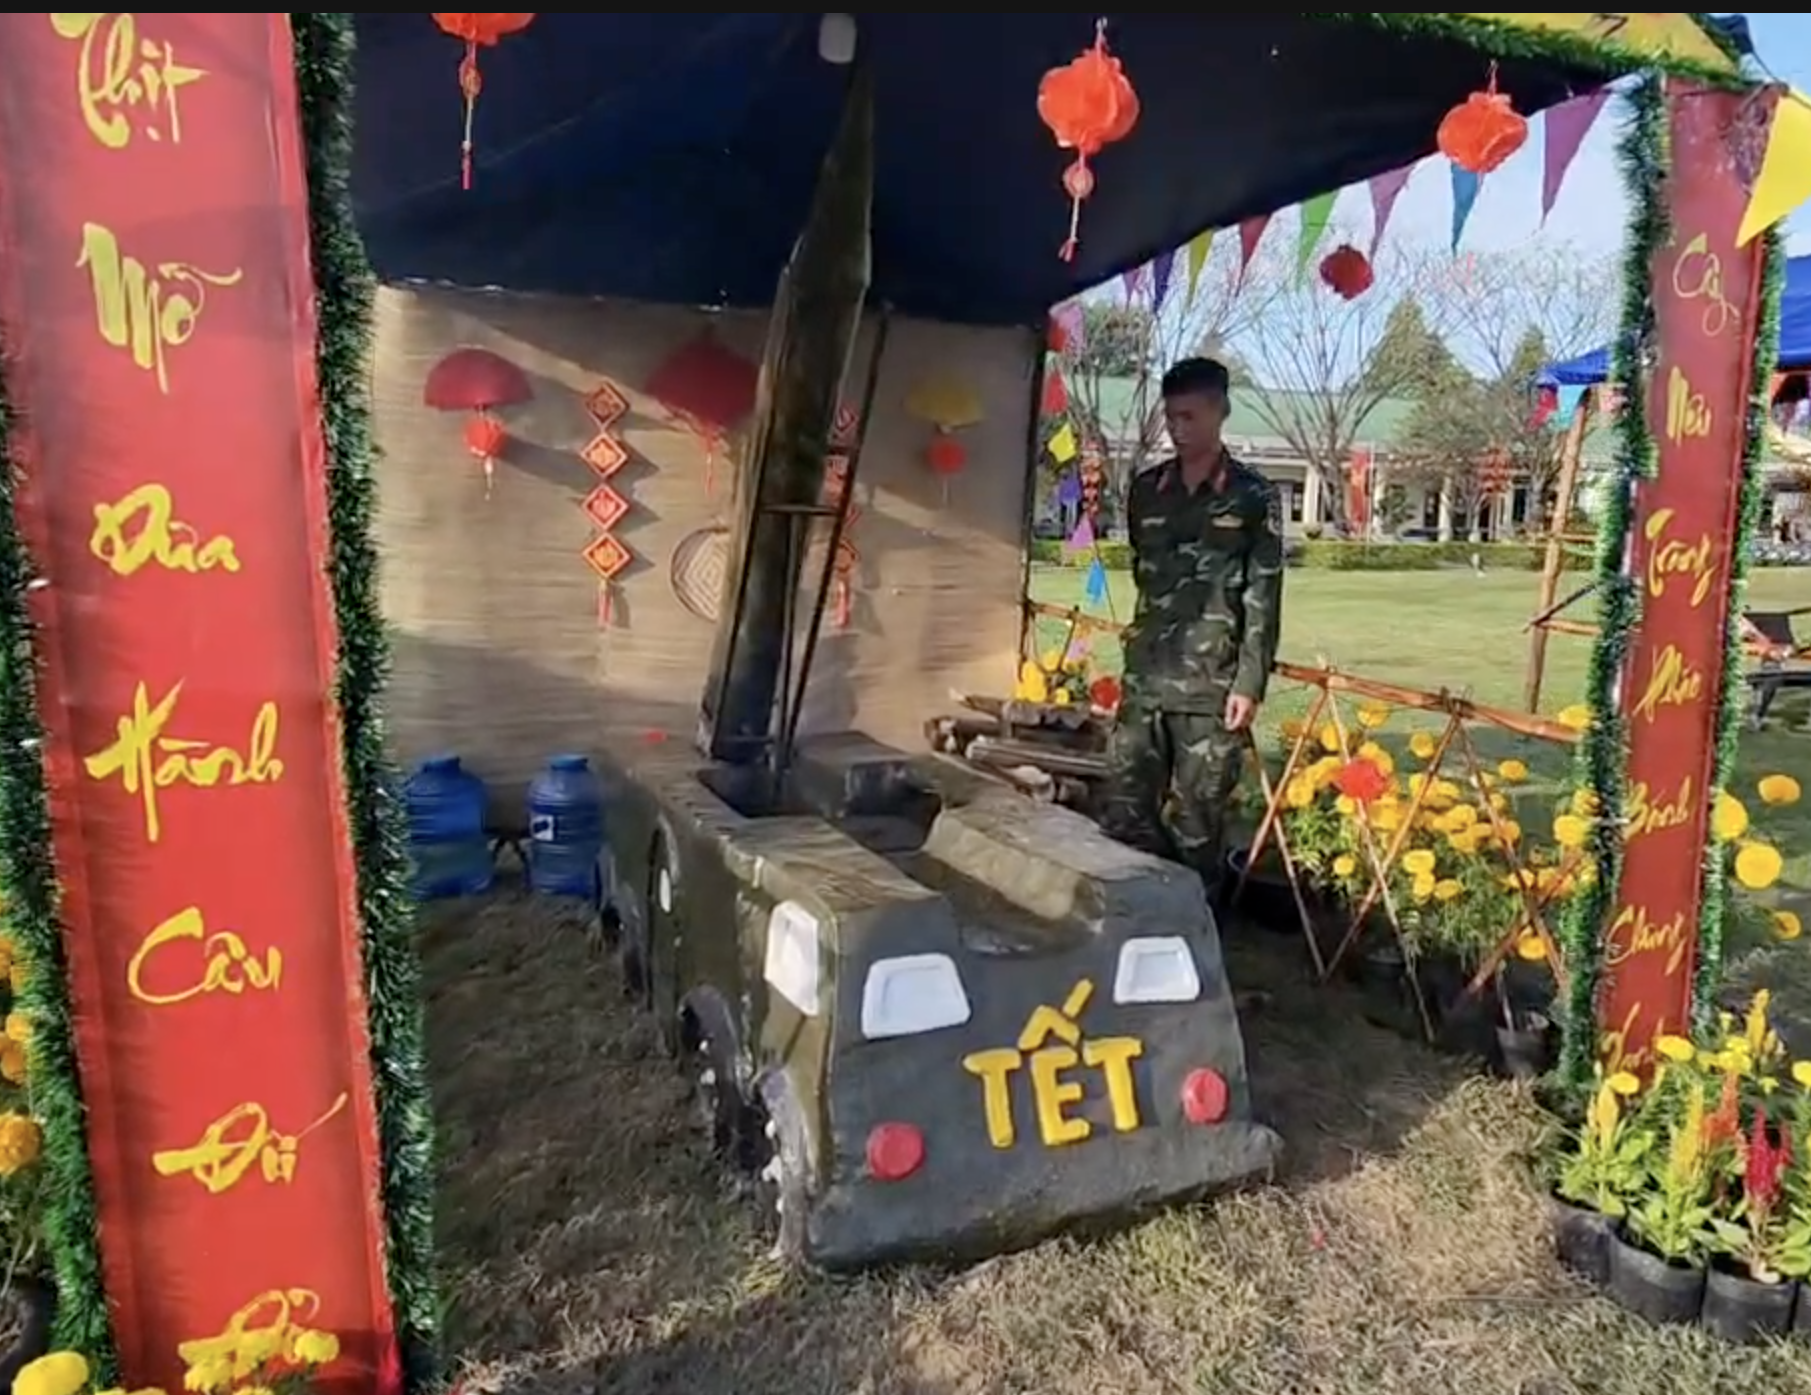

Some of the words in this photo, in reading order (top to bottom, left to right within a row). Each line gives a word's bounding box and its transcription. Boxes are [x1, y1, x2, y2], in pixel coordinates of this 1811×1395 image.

[1672, 232, 1740, 337] Cây
[1667, 366, 1712, 446] Nêu
[84, 676, 284, 842] Hành
[1621, 775, 1691, 841] Bánh
[128, 906, 282, 1004] Câu
[963, 978, 1143, 1147] TẾT
